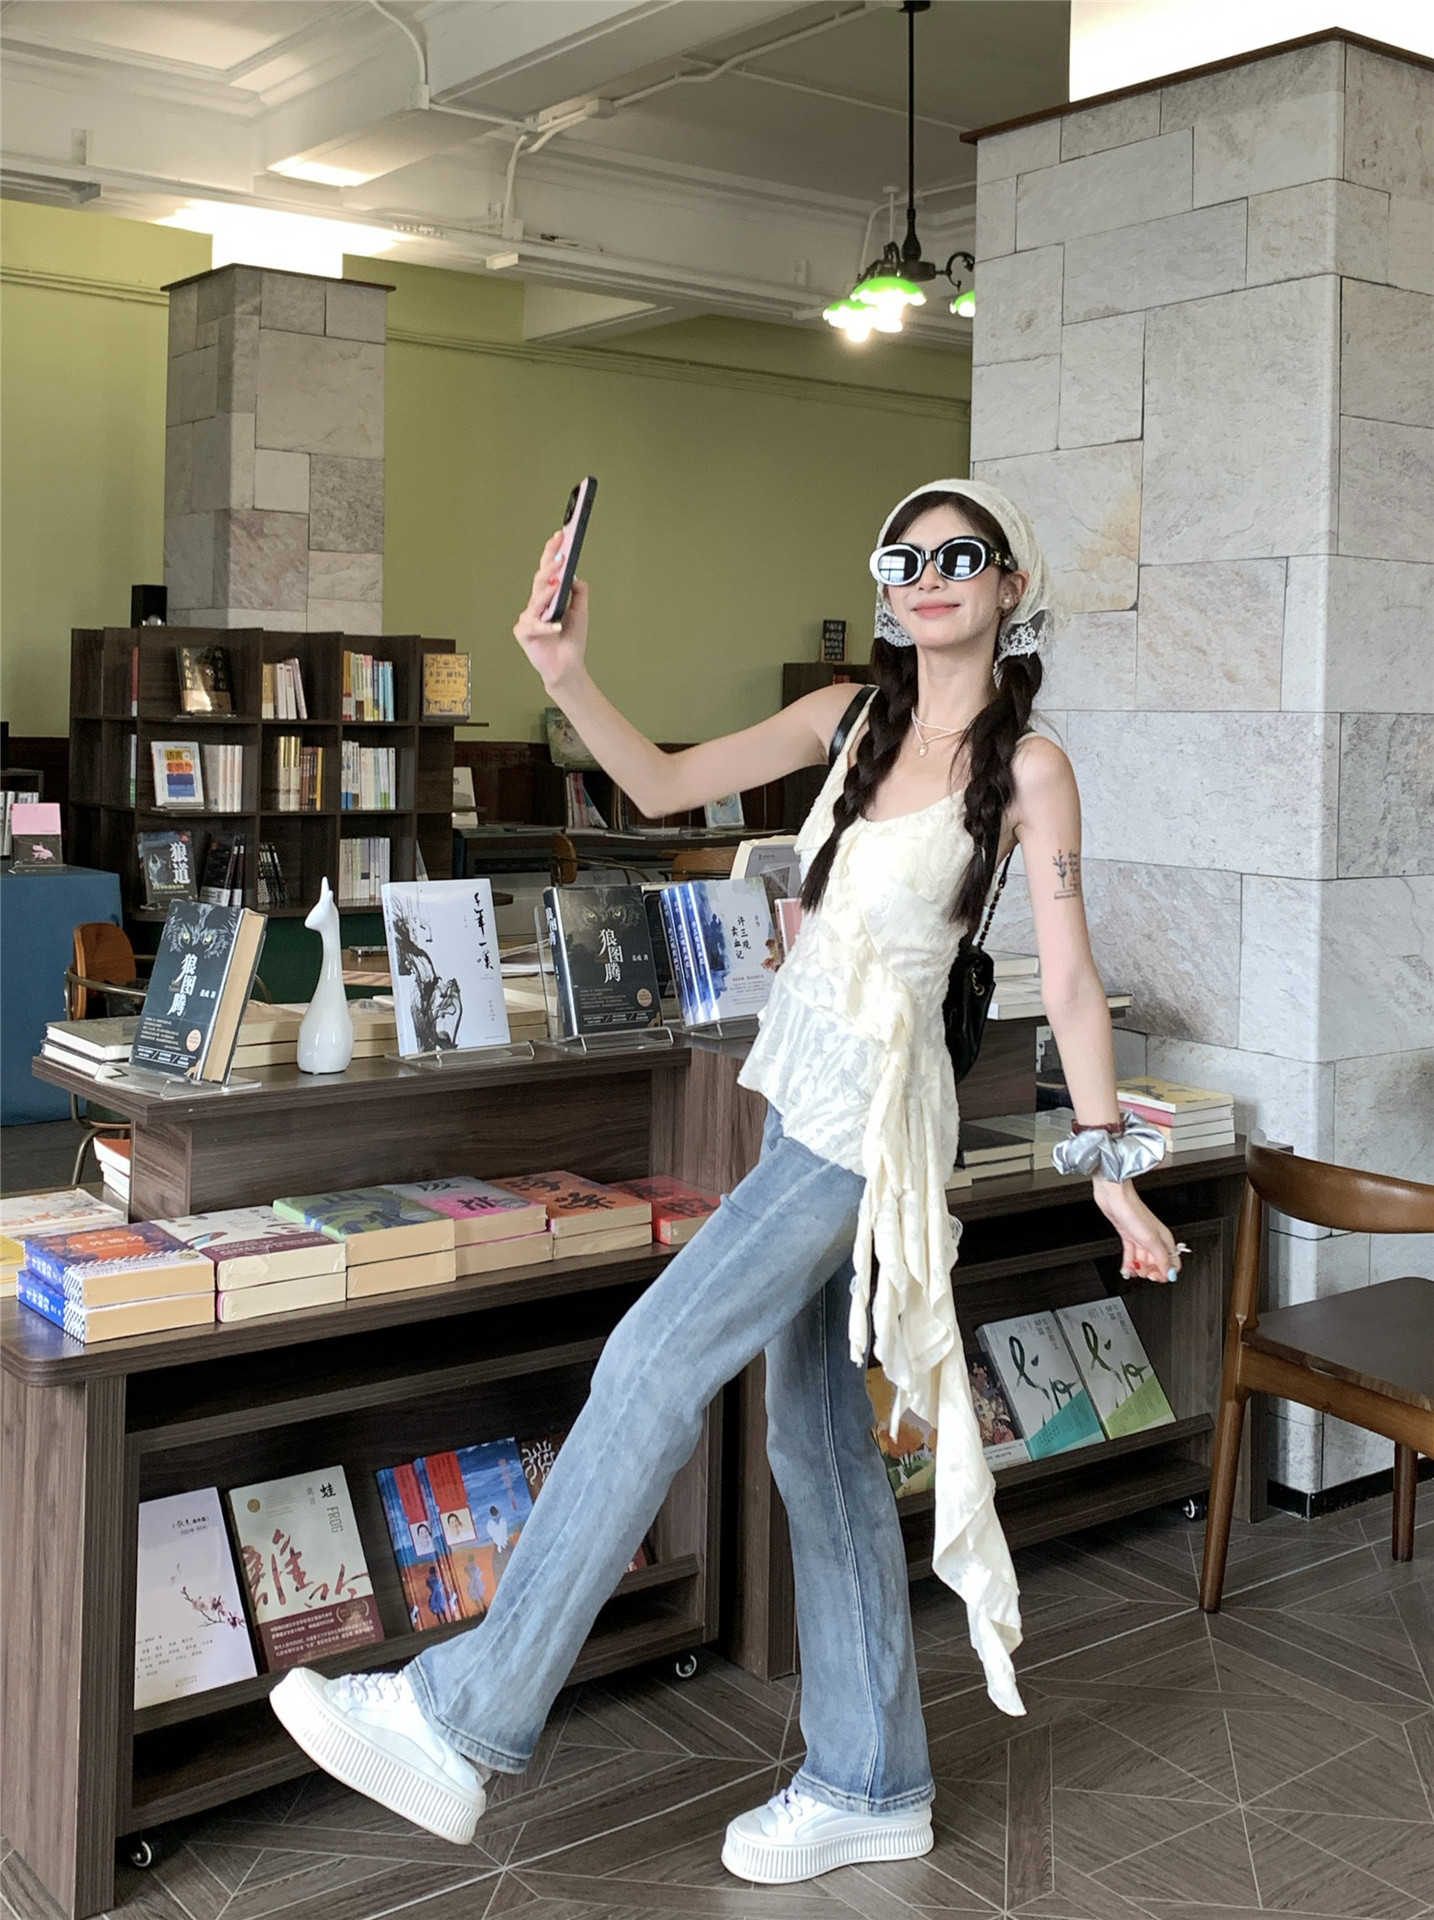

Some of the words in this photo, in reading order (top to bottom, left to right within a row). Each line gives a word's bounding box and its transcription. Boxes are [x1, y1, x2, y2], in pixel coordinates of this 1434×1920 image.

[169, 841, 191, 884] 狼道
[598, 928, 624, 984] 狼图腾
[166, 953, 198, 1017] 狼图腾
[319, 1482, 336, 1498] 蛙
[326, 1506, 344, 1533] FROG
